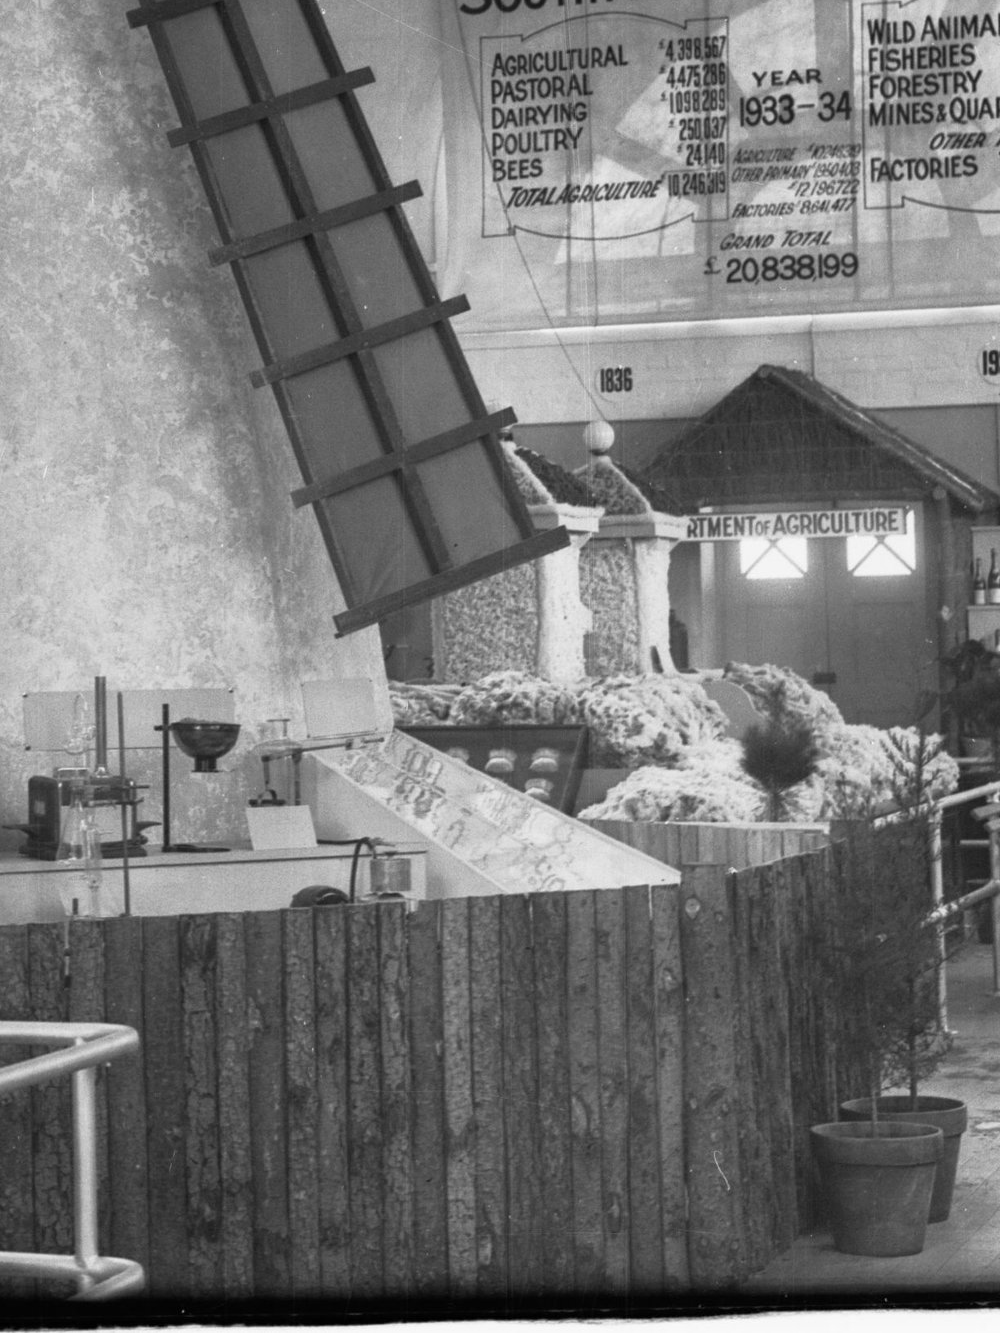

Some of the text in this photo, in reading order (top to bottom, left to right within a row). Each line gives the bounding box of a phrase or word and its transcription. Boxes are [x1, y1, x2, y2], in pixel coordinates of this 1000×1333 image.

[867, 12, 1000, 45] WILD ANIMA
[491, 45, 628, 77] AGRICULTURAL
[868, 43, 976, 73] FISHERIES
[491, 74, 593, 104] PASTORAL
[752, 69, 823, 88] YEAR
[869, 69, 983, 100] FORESTRY
[491, 102, 588, 130] DAIRYING
[492, 127, 584, 156] POULTRY
[929, 132, 987, 150] OTHER
[732, 148, 798, 164] AGRICULTURE
[870, 155, 978, 182] FACTORIES
[492, 158, 543, 182] BEES
[732, 167, 763, 183] OTHER
[763, 164, 812, 181] PRIMARY
[506, 186, 558, 208] TOTAL
[557, 179, 662, 205] AGRICULTURE
[732, 202, 795, 218] FACTORIES
[720, 230, 833, 251] GRAND TOTAL
[982, 350, 1000, 377] 19
[600, 367, 633, 393] 1836
[755, 520, 771, 537] OF
[772, 510, 900, 536] AGRICULTURE
